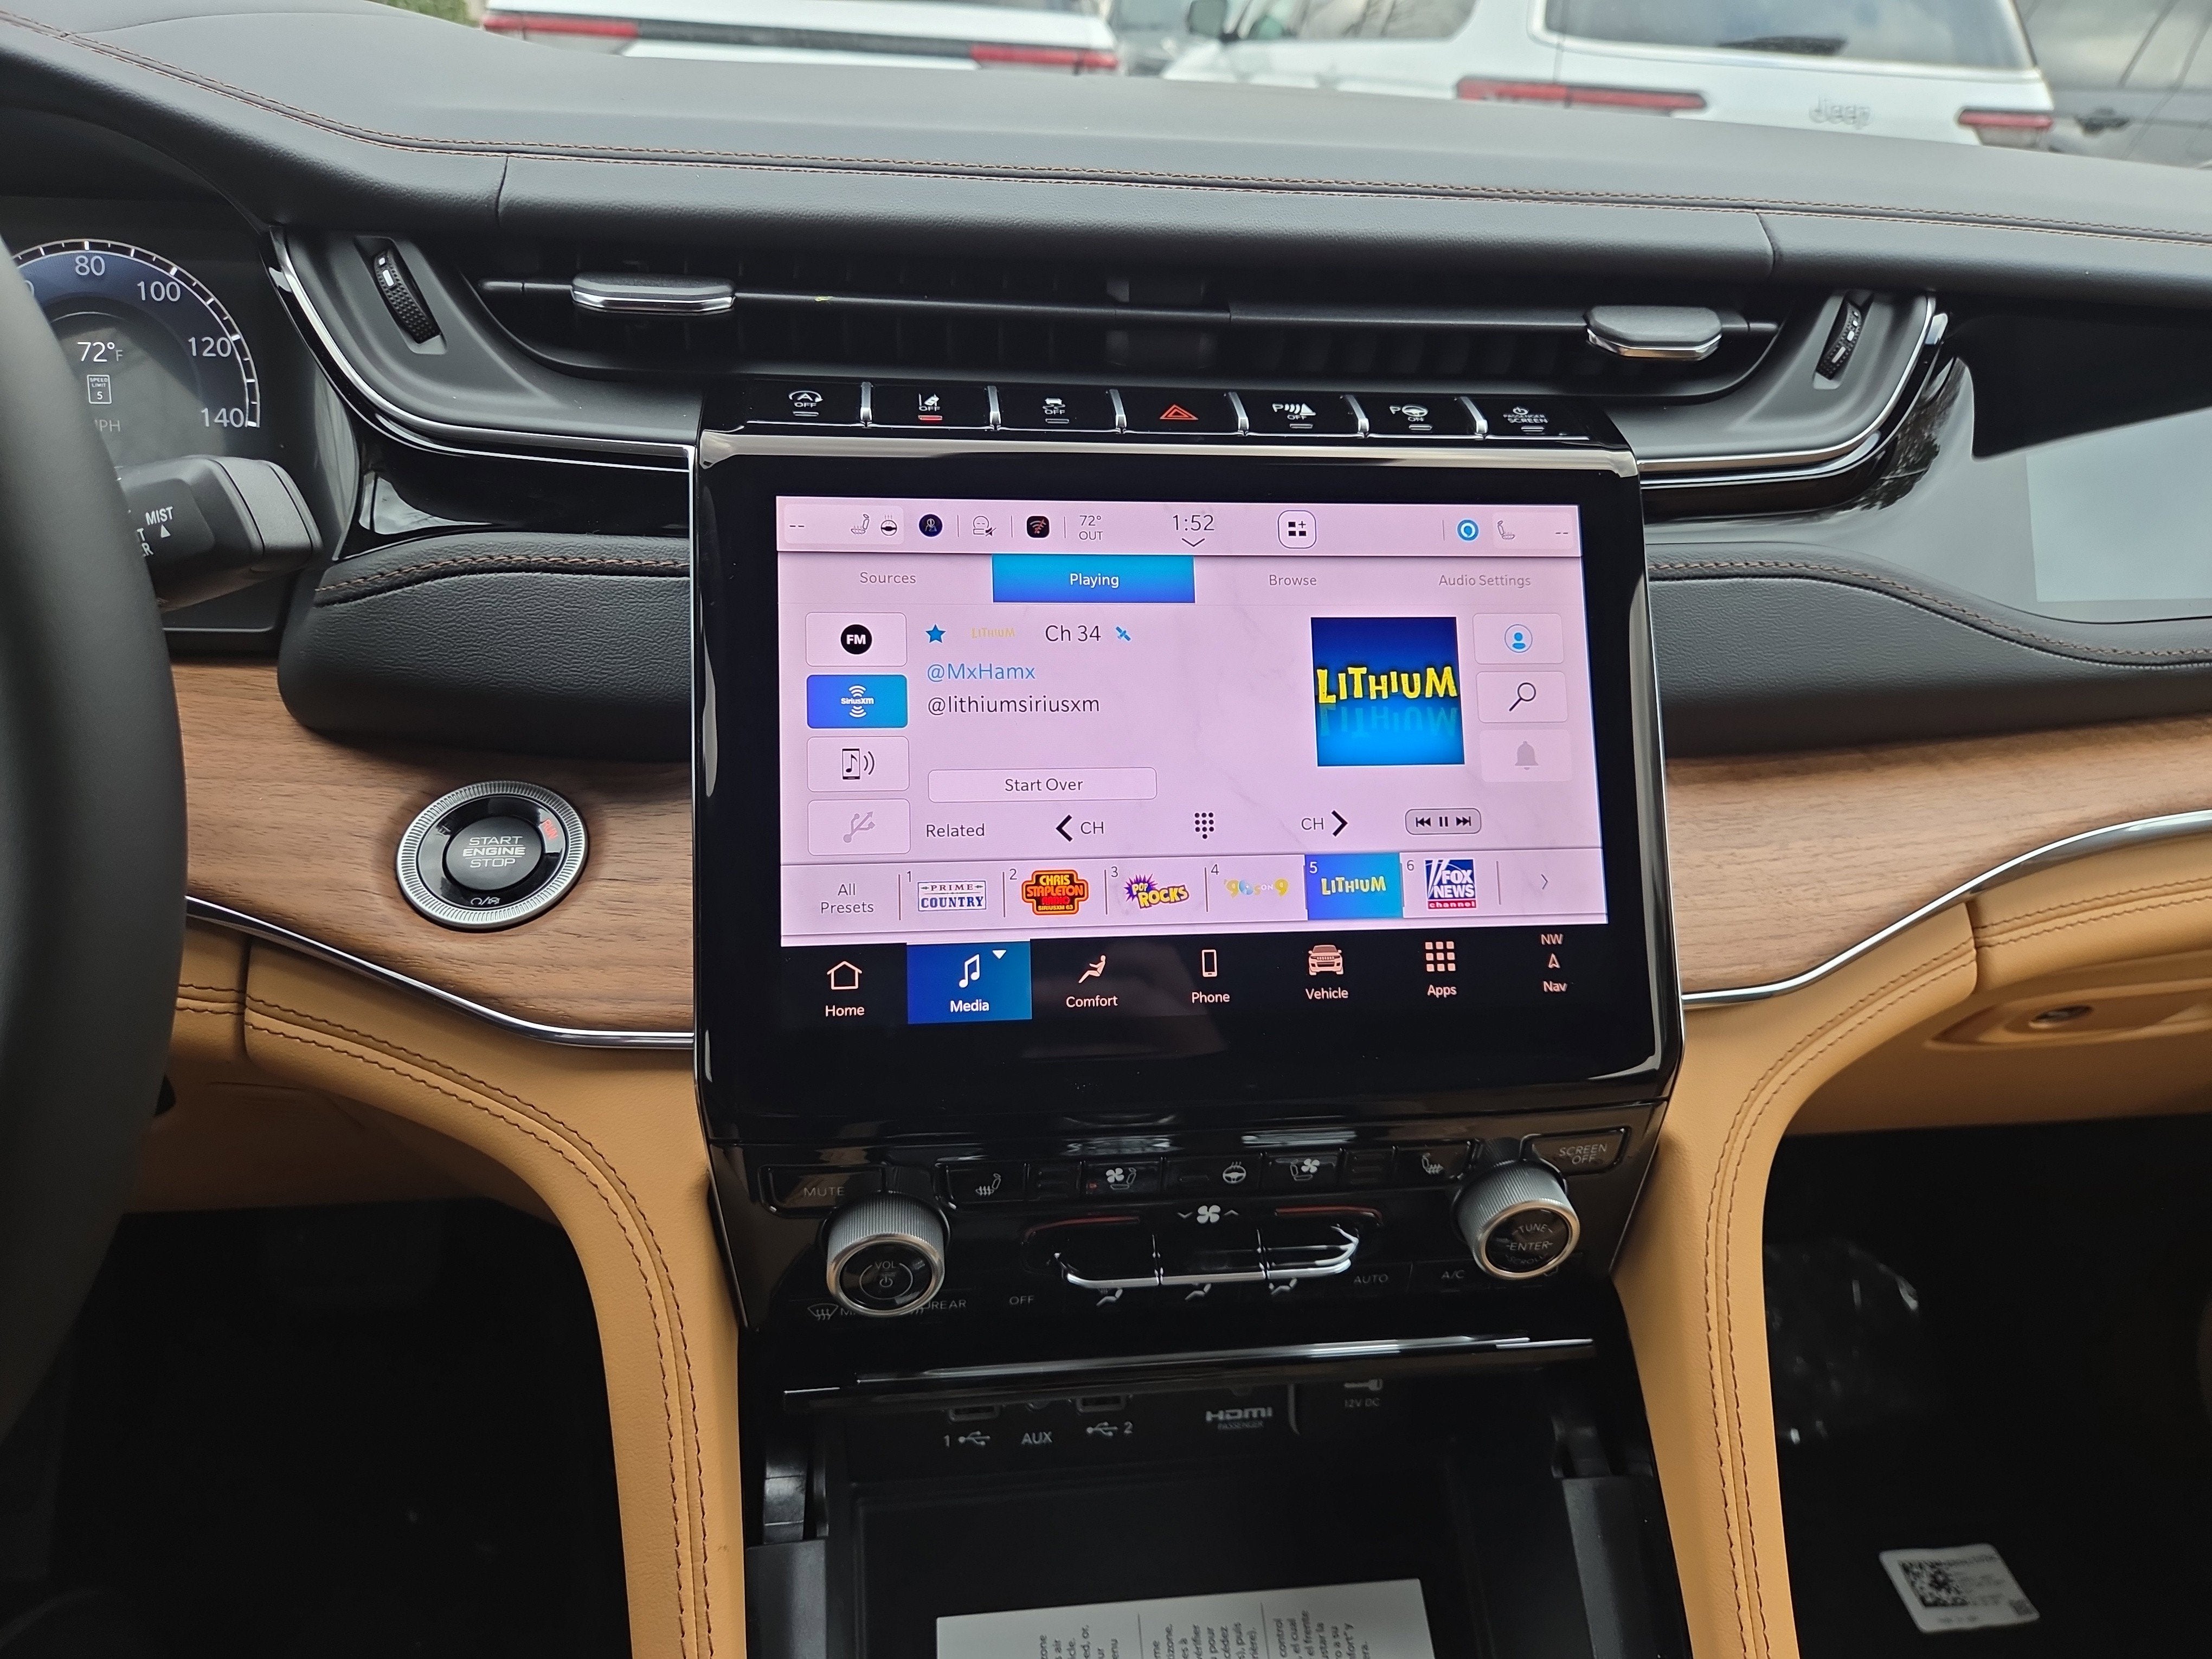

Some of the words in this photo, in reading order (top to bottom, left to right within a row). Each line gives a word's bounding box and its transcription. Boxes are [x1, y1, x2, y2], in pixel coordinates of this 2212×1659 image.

[1809, 96, 1870, 130] Jeep
[75, 256, 105, 275] 80
[137, 281, 181, 302] 100
[188, 337, 232, 357] 120
[97, 391, 103, 400] 5
[201, 408, 244, 428] 140
[145, 505, 173, 526] MIST
[1079, 515, 1102, 527] 72°
[1172, 515, 1215, 532] 1:52
[1079, 530, 1103, 541] OUT
[859, 572, 916, 585] Sources
[1070, 573, 1119, 588] Playing
[1269, 574, 1317, 586] Browse
[1439, 574, 1476, 587] Audio
[1479, 575, 1531, 589] Settings
[846, 634, 866, 645] FM
[1045, 625, 1072, 642] Ch
[1077, 626, 1102, 641] 34
[928, 663, 1036, 682] @MxHamx
[928, 695, 1099, 716] @lithiumsiriusxm
[1005, 779, 1041, 792] Start
[1046, 778, 1083, 792] Over
[543, 819, 558, 840] RUN
[926, 823, 985, 838] Related
[1081, 821, 1104, 835] CH
[1302, 818, 1324, 831] CH
[469, 836, 523, 845] START
[463, 847, 525, 857] ENGINE
[470, 858, 516, 868] STOP
[1309, 861, 1318, 873] 5
[1407, 860, 1414, 871] 6
[906, 871, 912, 882] 1
[1009, 869, 1018, 880] 2
[1111, 866, 1118, 877] 3
[1211, 864, 1220, 876] 4
[1039, 874, 1071, 885] CHRIS
[1441, 870, 1472, 884] FOX
[838, 883, 856, 897] All
[930, 884, 974, 892] PRIME
[1027, 885, 1084, 897] STAPLETON
[1132, 883, 1148, 895] POP
[1275, 878, 1289, 898] 9
[1432, 885, 1475, 898] NEWS
[921, 896, 984, 909] COUNTRY
[1138, 886, 1189, 908] ROCKS
[820, 901, 874, 914] Presets
[1541, 934, 1563, 944] NW
[1306, 986, 1348, 1000] Vehicle
[1427, 984, 1457, 998] Apps
[1543, 980, 1567, 993] Nav
[1066, 994, 1118, 1007] Comfort
[1192, 991, 1230, 1004] Phone
[825, 1005, 865, 1017] Home
[950, 999, 989, 1012] Media
[1558, 1144, 1607, 1156] SCREEN
[1572, 1154, 1596, 1164] OFF
[803, 1187, 845, 1197] MUTE
[1517, 1223, 1548, 1233] TUNE
[1509, 1240, 1550, 1251] ENTER
[874, 1261, 896, 1270] VOL
[1353, 1274, 1388, 1284] AUTO
[1441, 1270, 1465, 1280] A/C
[931, 1299, 967, 1309] REAR
[1009, 1295, 1034, 1305] OFF
[1345, 1398, 1361, 1409] 12V
[1365, 1398, 1381, 1407] DC
[1205, 1407, 1274, 1423] HDMI
[1124, 1421, 1134, 1434] 2
[944, 1435, 950, 1447] 1
[1021, 1431, 1053, 1445] AUX
